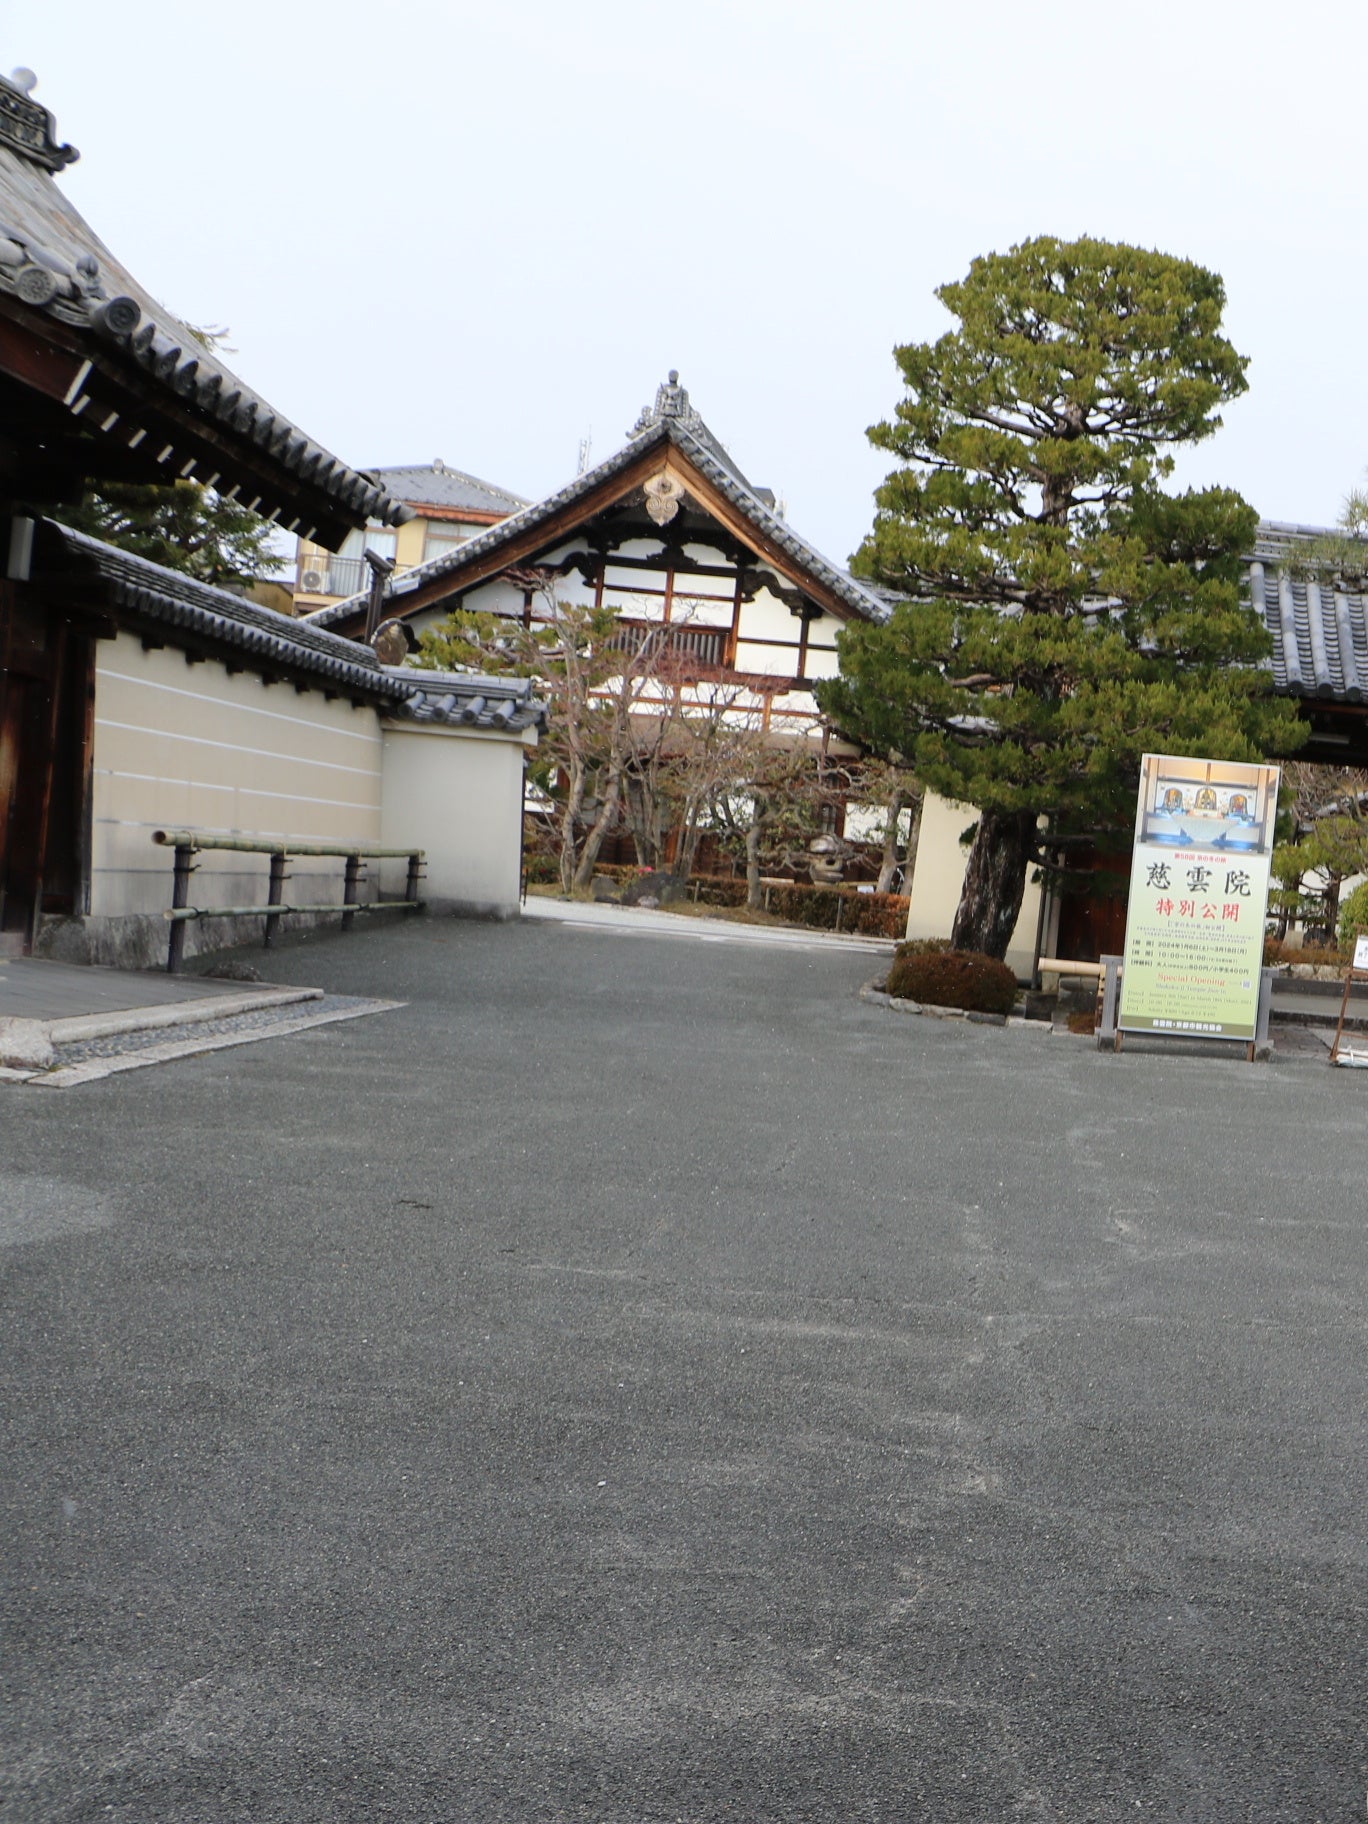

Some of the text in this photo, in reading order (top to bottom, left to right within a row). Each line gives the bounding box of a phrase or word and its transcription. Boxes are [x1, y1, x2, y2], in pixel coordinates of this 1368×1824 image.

[1146, 862, 1251, 896] 慈雲院
[1156, 898, 1240, 922] 特別公開
[1158, 973, 1188, 984] Special
[1190, 975, 1225, 987] Opening
